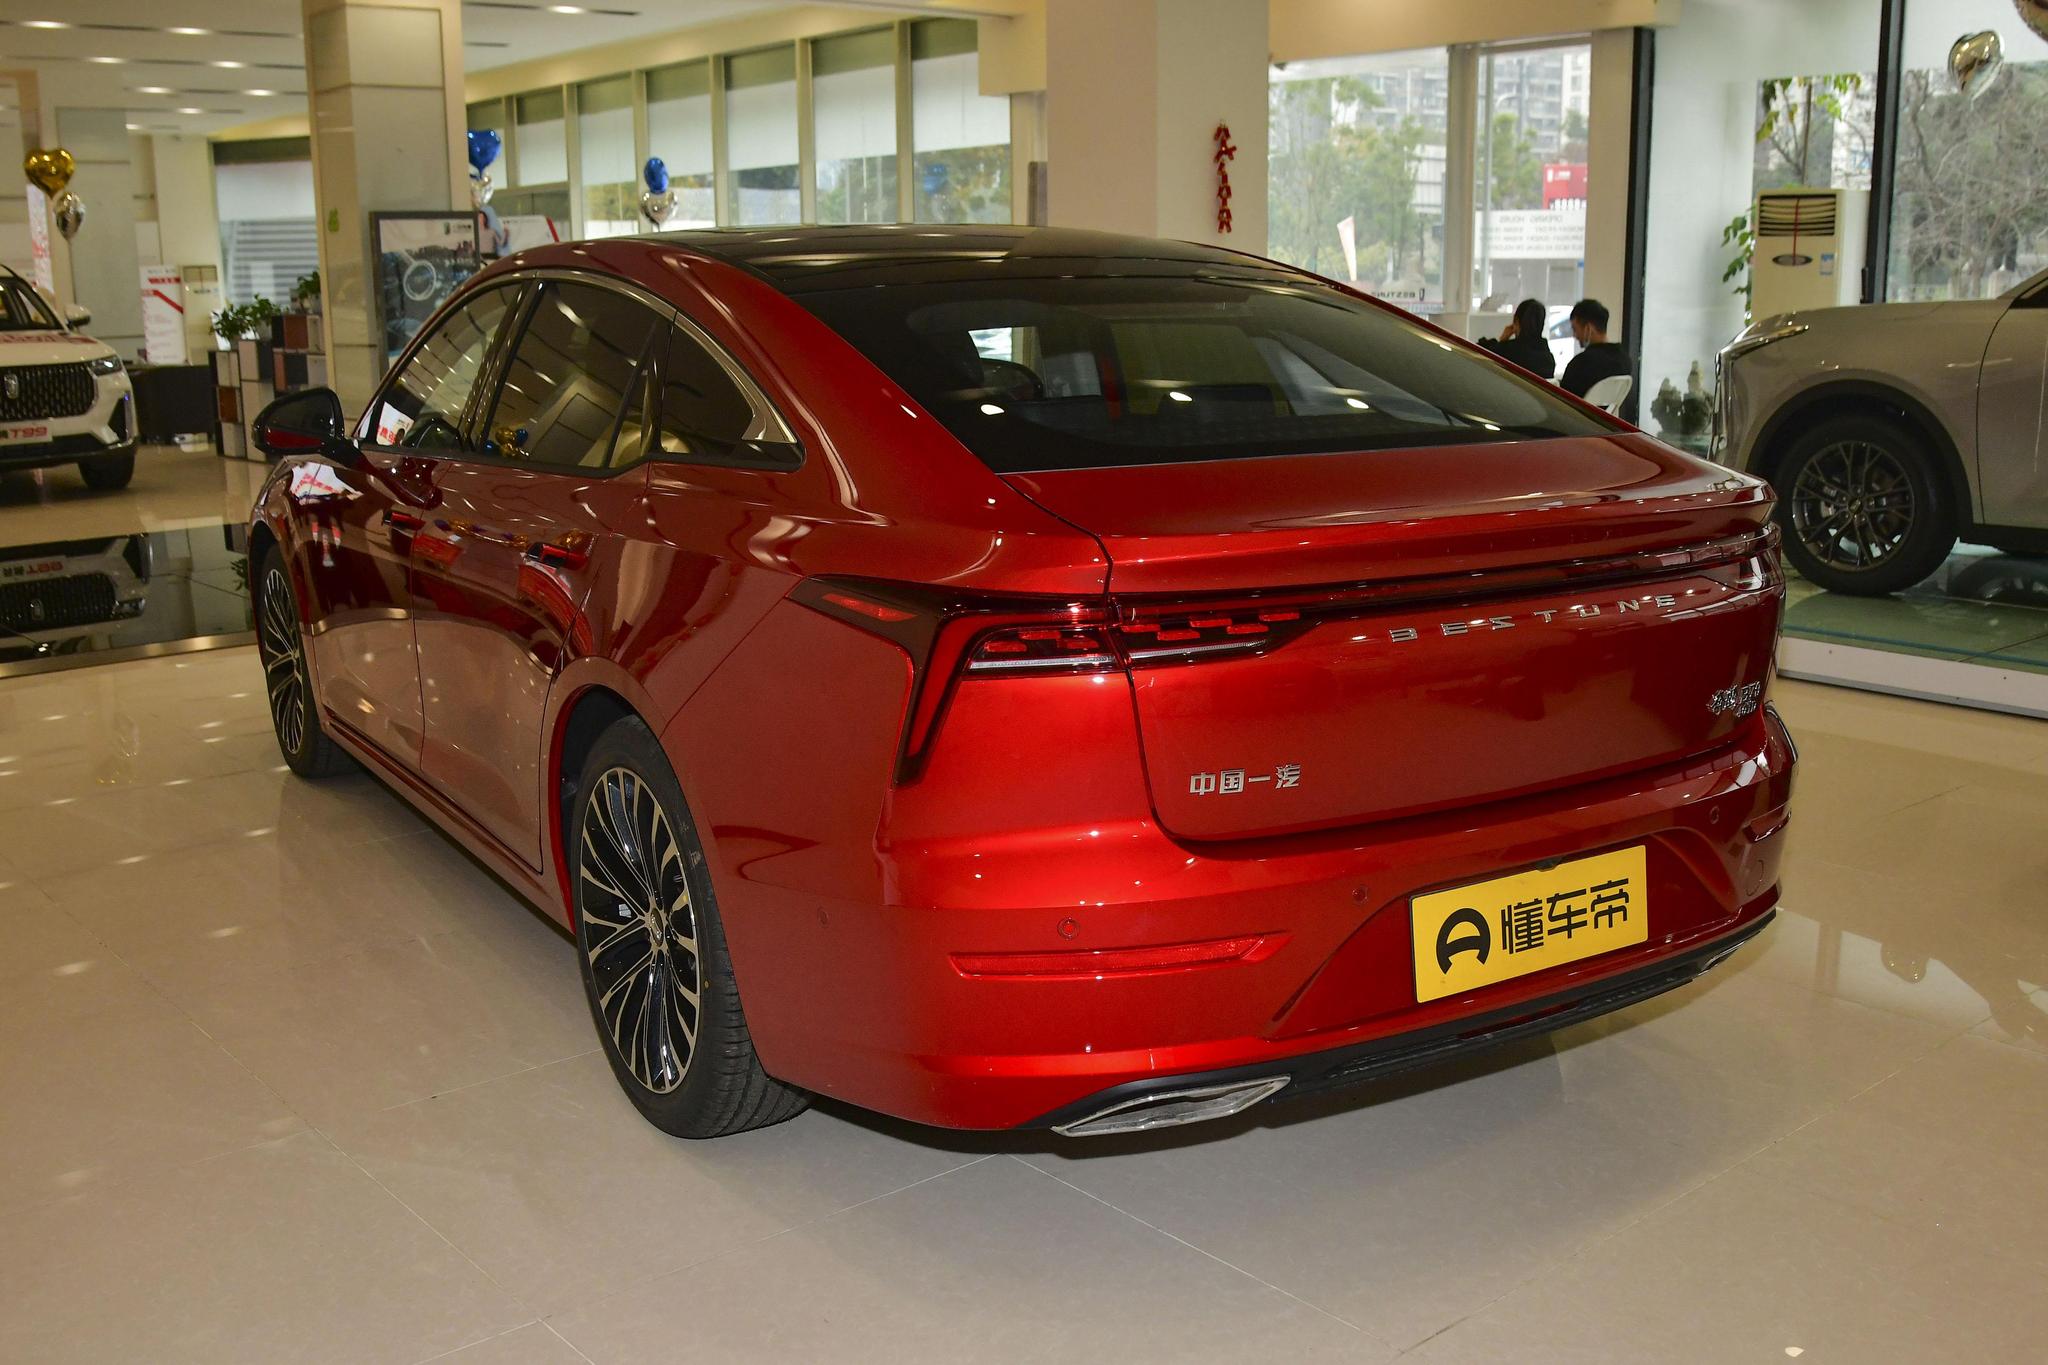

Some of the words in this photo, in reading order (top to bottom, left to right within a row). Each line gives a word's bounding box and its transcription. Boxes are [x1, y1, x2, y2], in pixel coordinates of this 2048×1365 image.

[1388, 594, 1676, 643] BESTUNE
[1189, 764, 1301, 796] 中国一汽
[1500, 877, 1630, 955] 懂车帝
